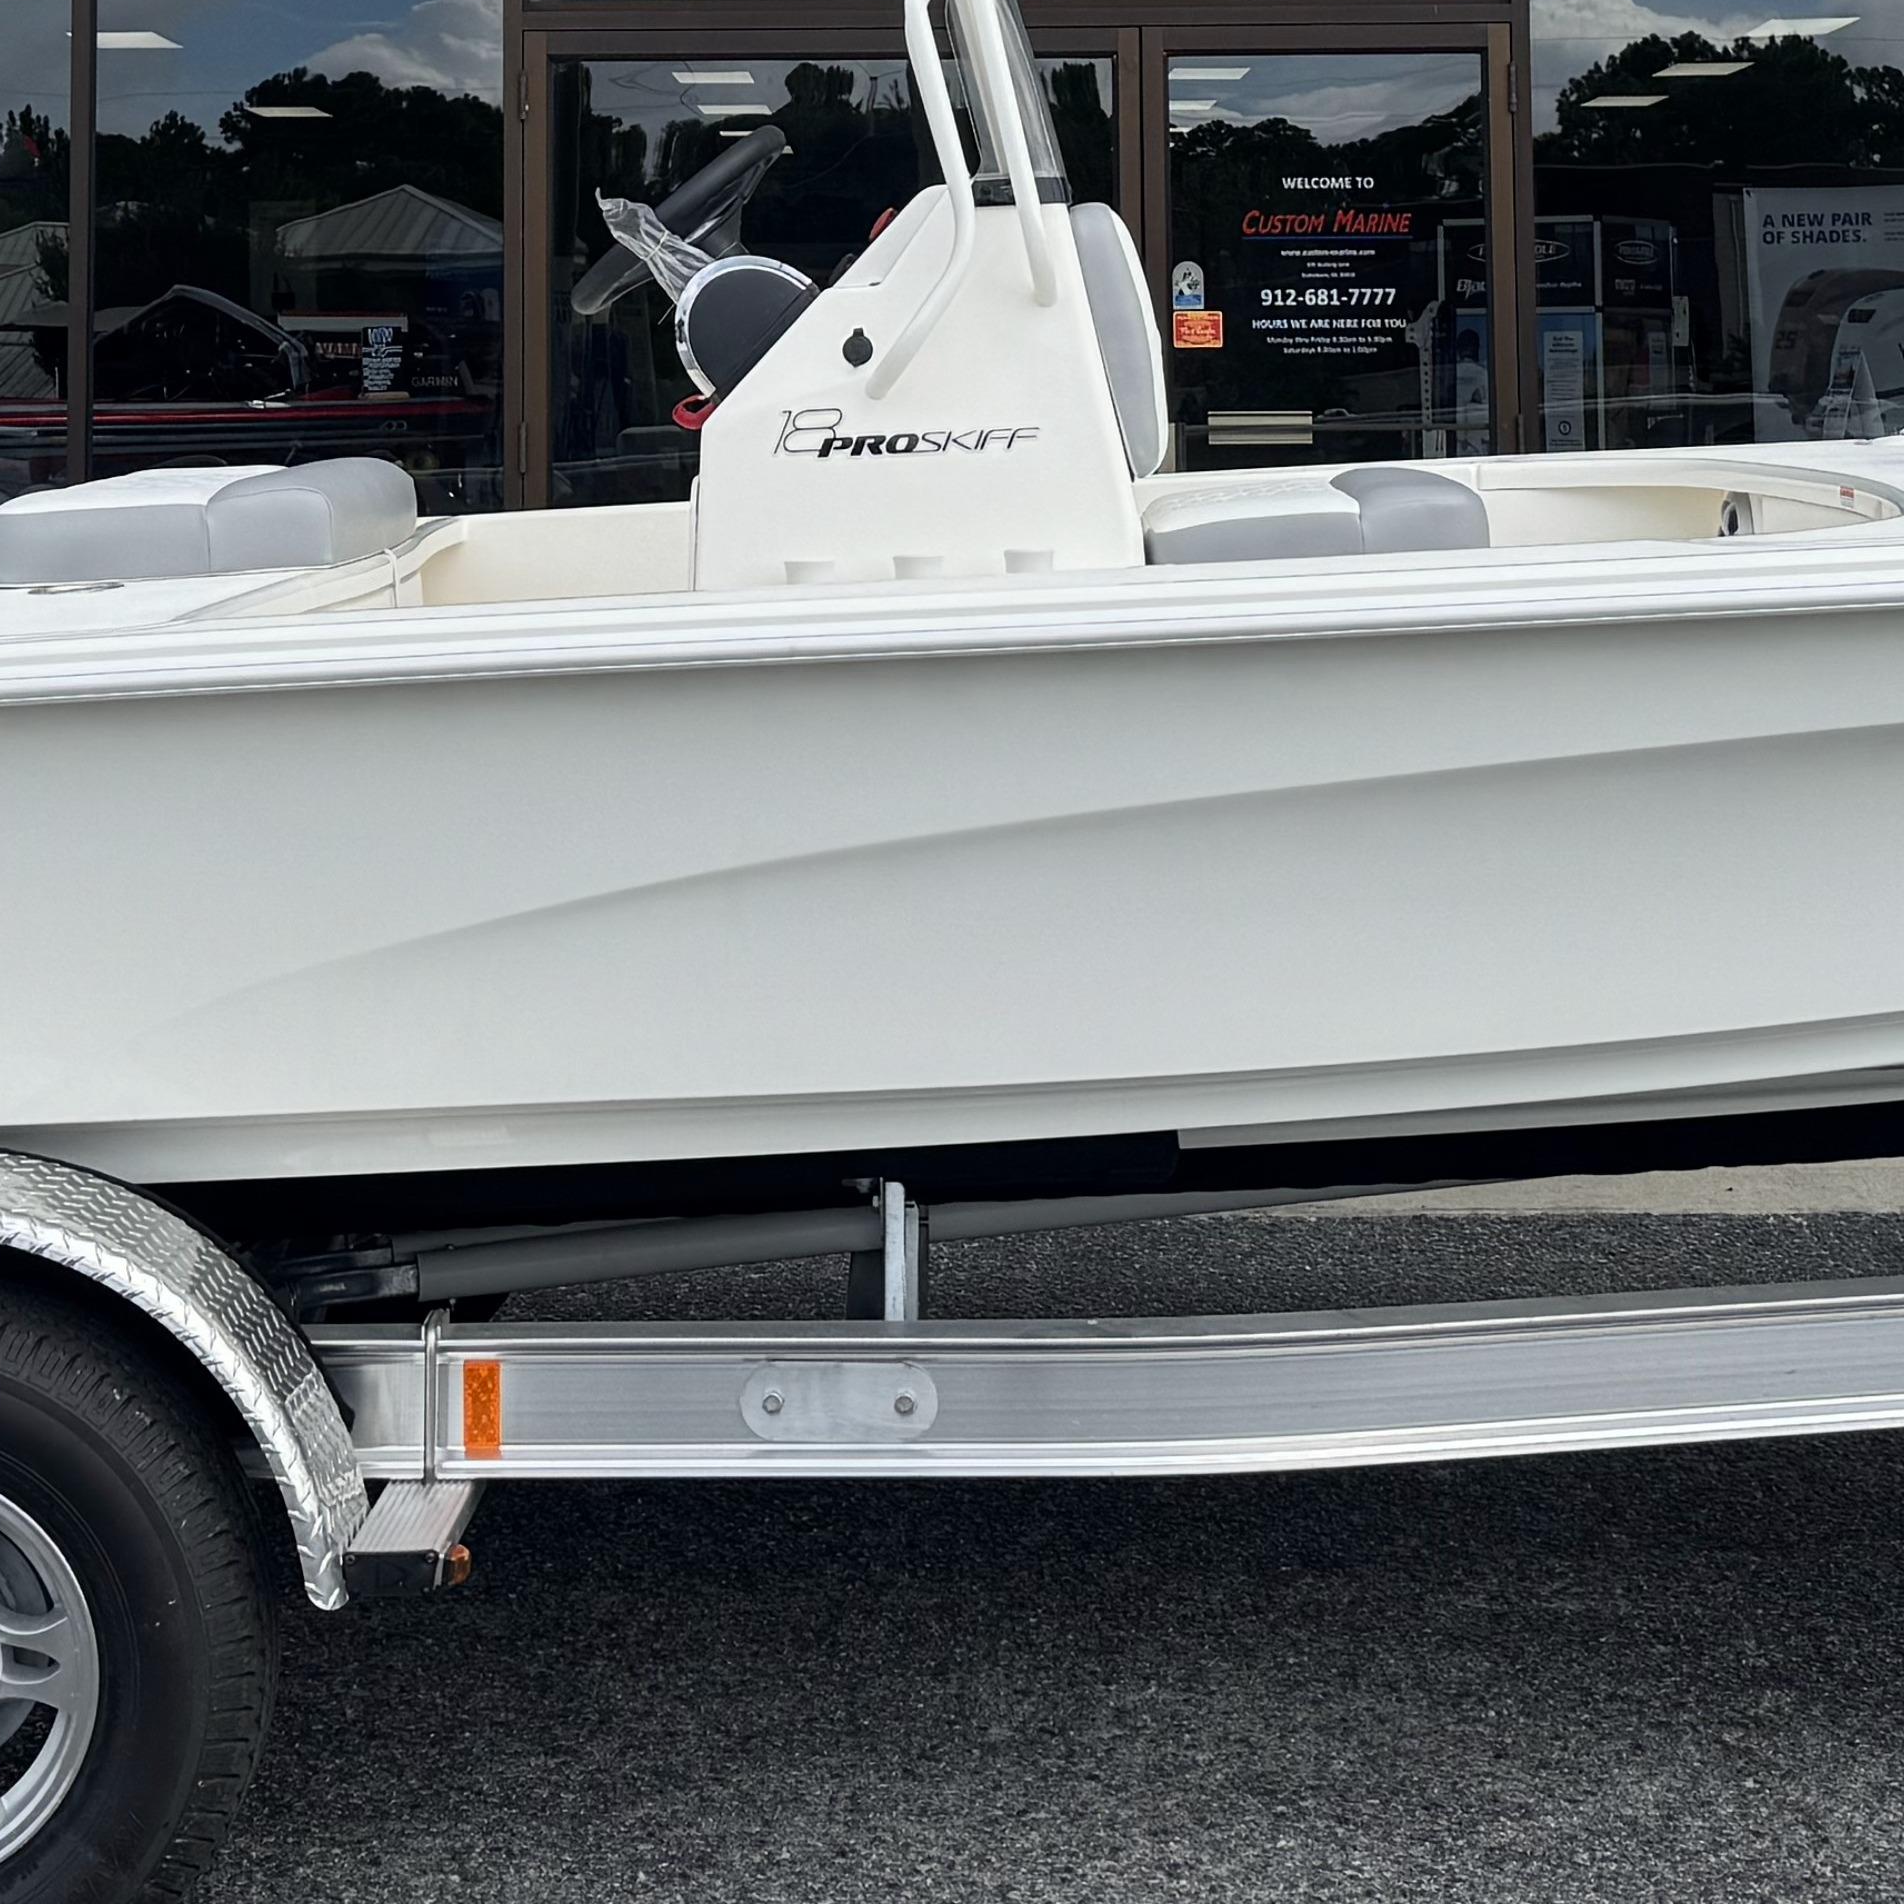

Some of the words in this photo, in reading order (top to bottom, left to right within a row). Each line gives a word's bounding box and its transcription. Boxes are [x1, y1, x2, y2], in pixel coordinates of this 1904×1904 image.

[1282, 177, 1352, 189] WELCOME
[1355, 177, 1375, 189] TO
[1242, 209, 1325, 234] CUSTOM
[1333, 208, 1412, 233] MARINE
[1763, 214, 1776, 228] A
[1781, 213, 1825, 227] NEW
[1831, 212, 1873, 226] PAIR
[1762, 230, 1785, 244] OF
[1791, 229, 1867, 244] SHADES.
[1260, 288, 1396, 306] 912-681-7777
[1252, 319, 1288, 329] HOURS
[1310, 319, 1330, 329] ARE
[411, 376, 458, 387] GARMIN
[774, 407, 843, 455] 18
